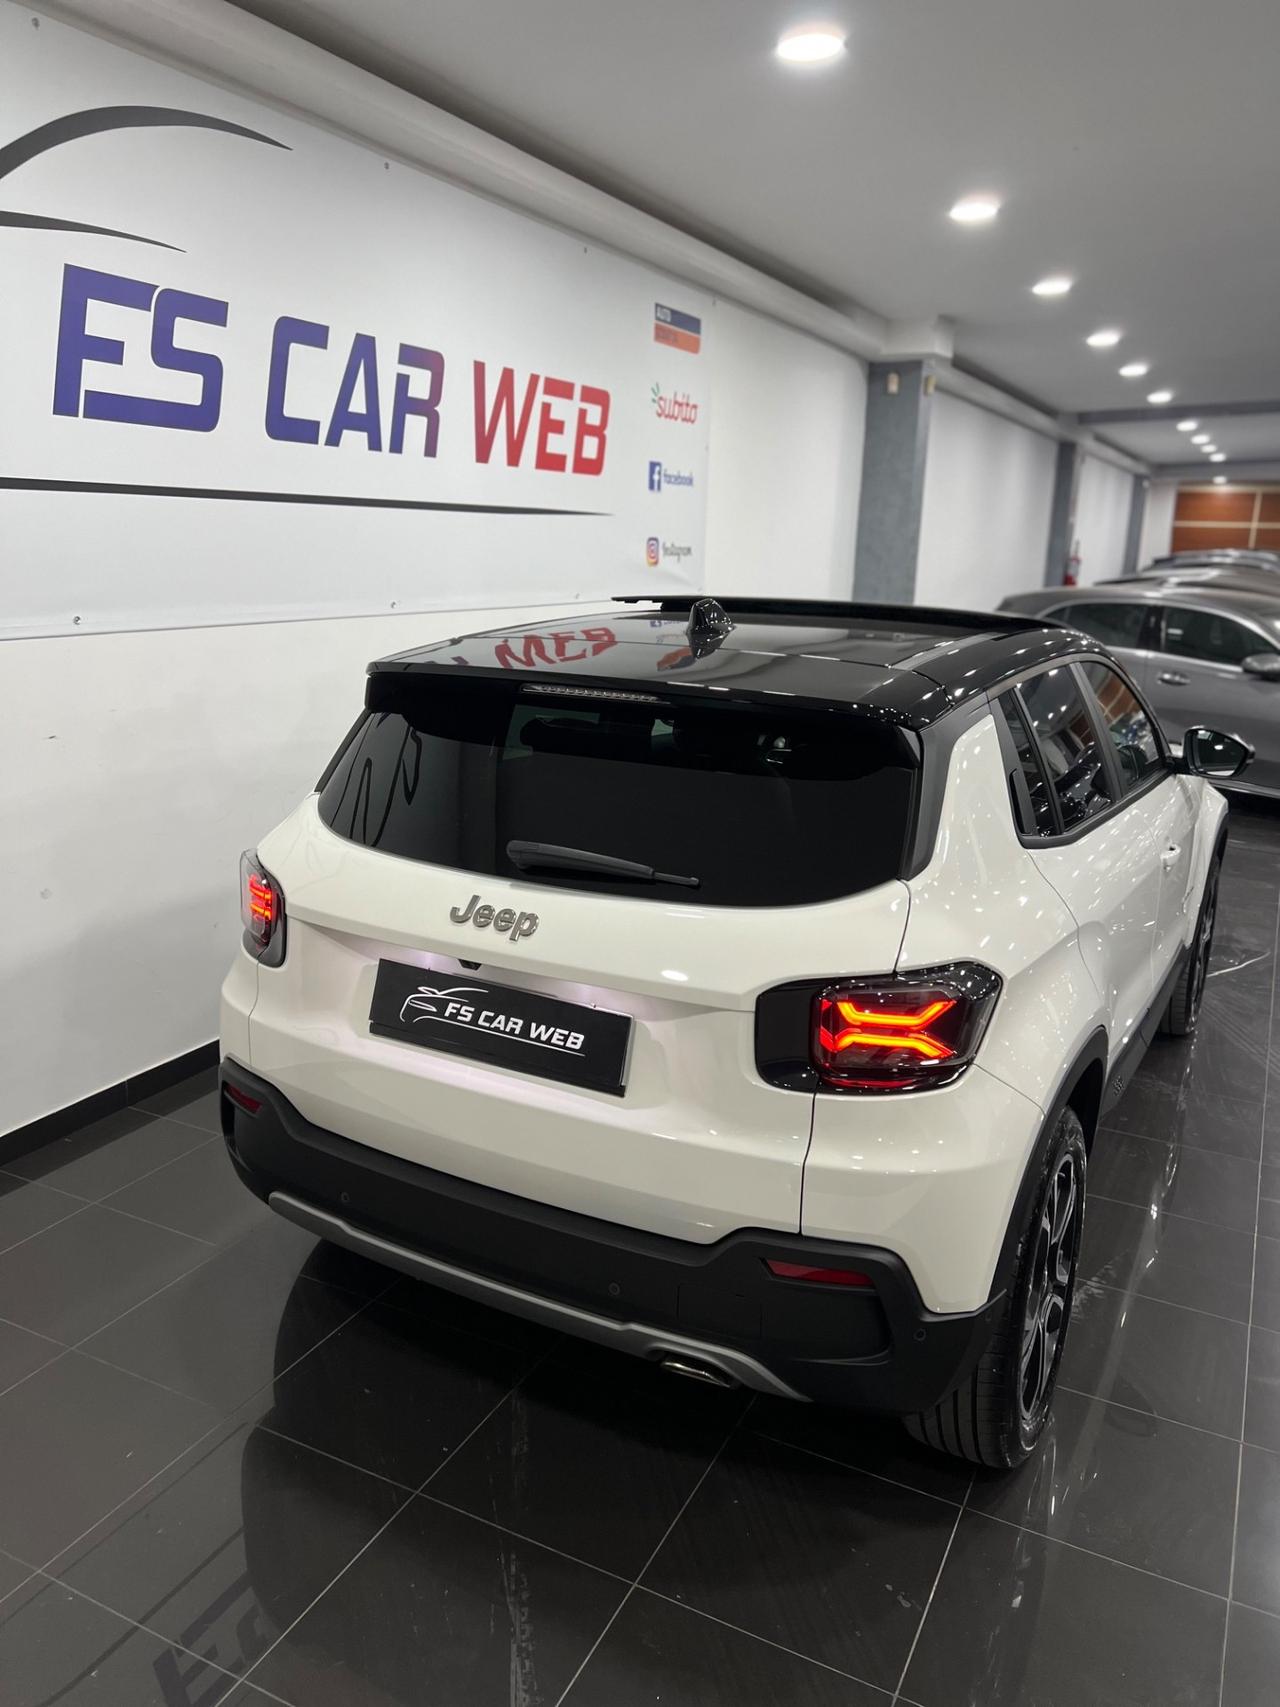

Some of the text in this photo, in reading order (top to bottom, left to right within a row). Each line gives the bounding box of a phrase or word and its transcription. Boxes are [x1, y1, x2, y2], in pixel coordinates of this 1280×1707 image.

[265, 315, 445, 458] CAR
[473, 360, 611, 476] WEB
[656, 391, 698, 424] subito
[450, 894, 539, 941] Jeep
[444, 1003, 585, 1050] FS CAR WEB
